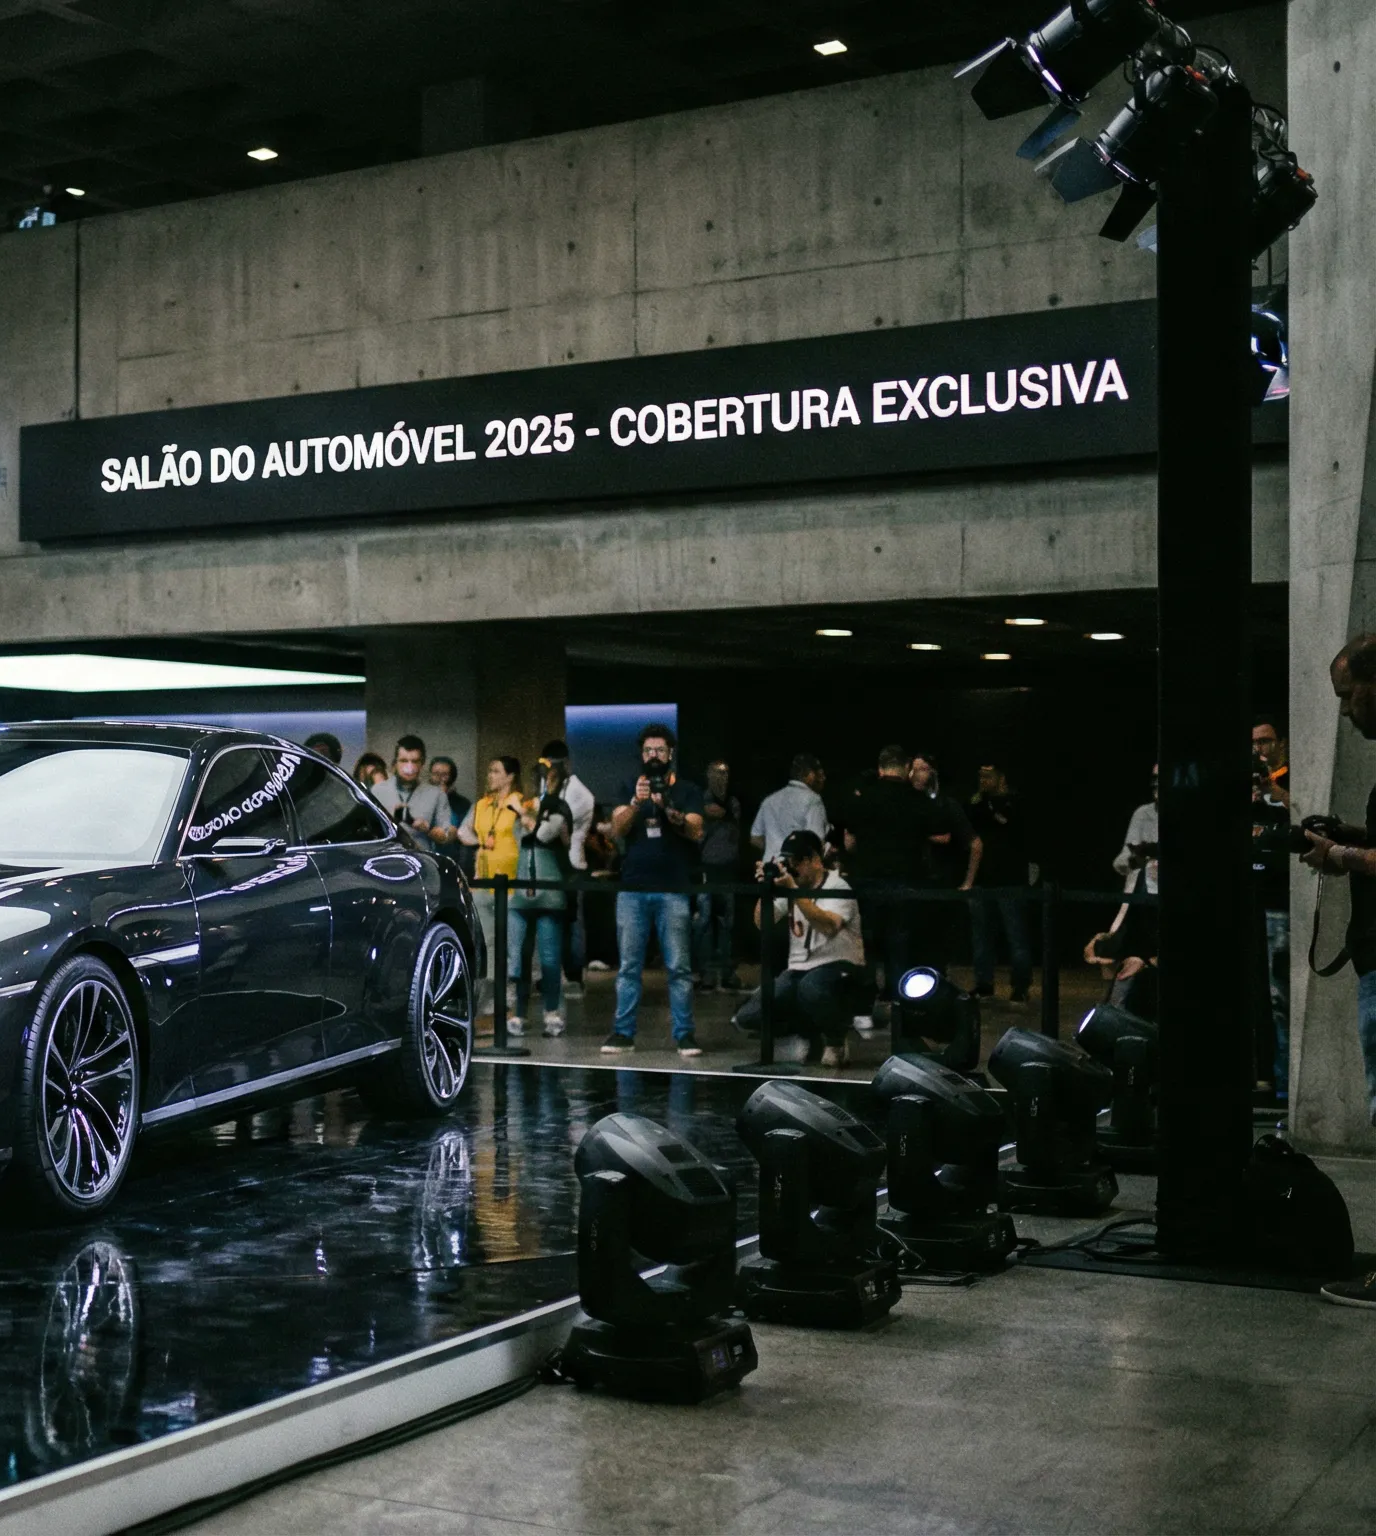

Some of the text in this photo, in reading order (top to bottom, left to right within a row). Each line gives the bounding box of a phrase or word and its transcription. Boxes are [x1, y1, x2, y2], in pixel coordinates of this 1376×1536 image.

[100, 358, 1129, 493] SALÃO DO AUTOMÓVEL 2025 - COBERTURA EXCLUSIVA
